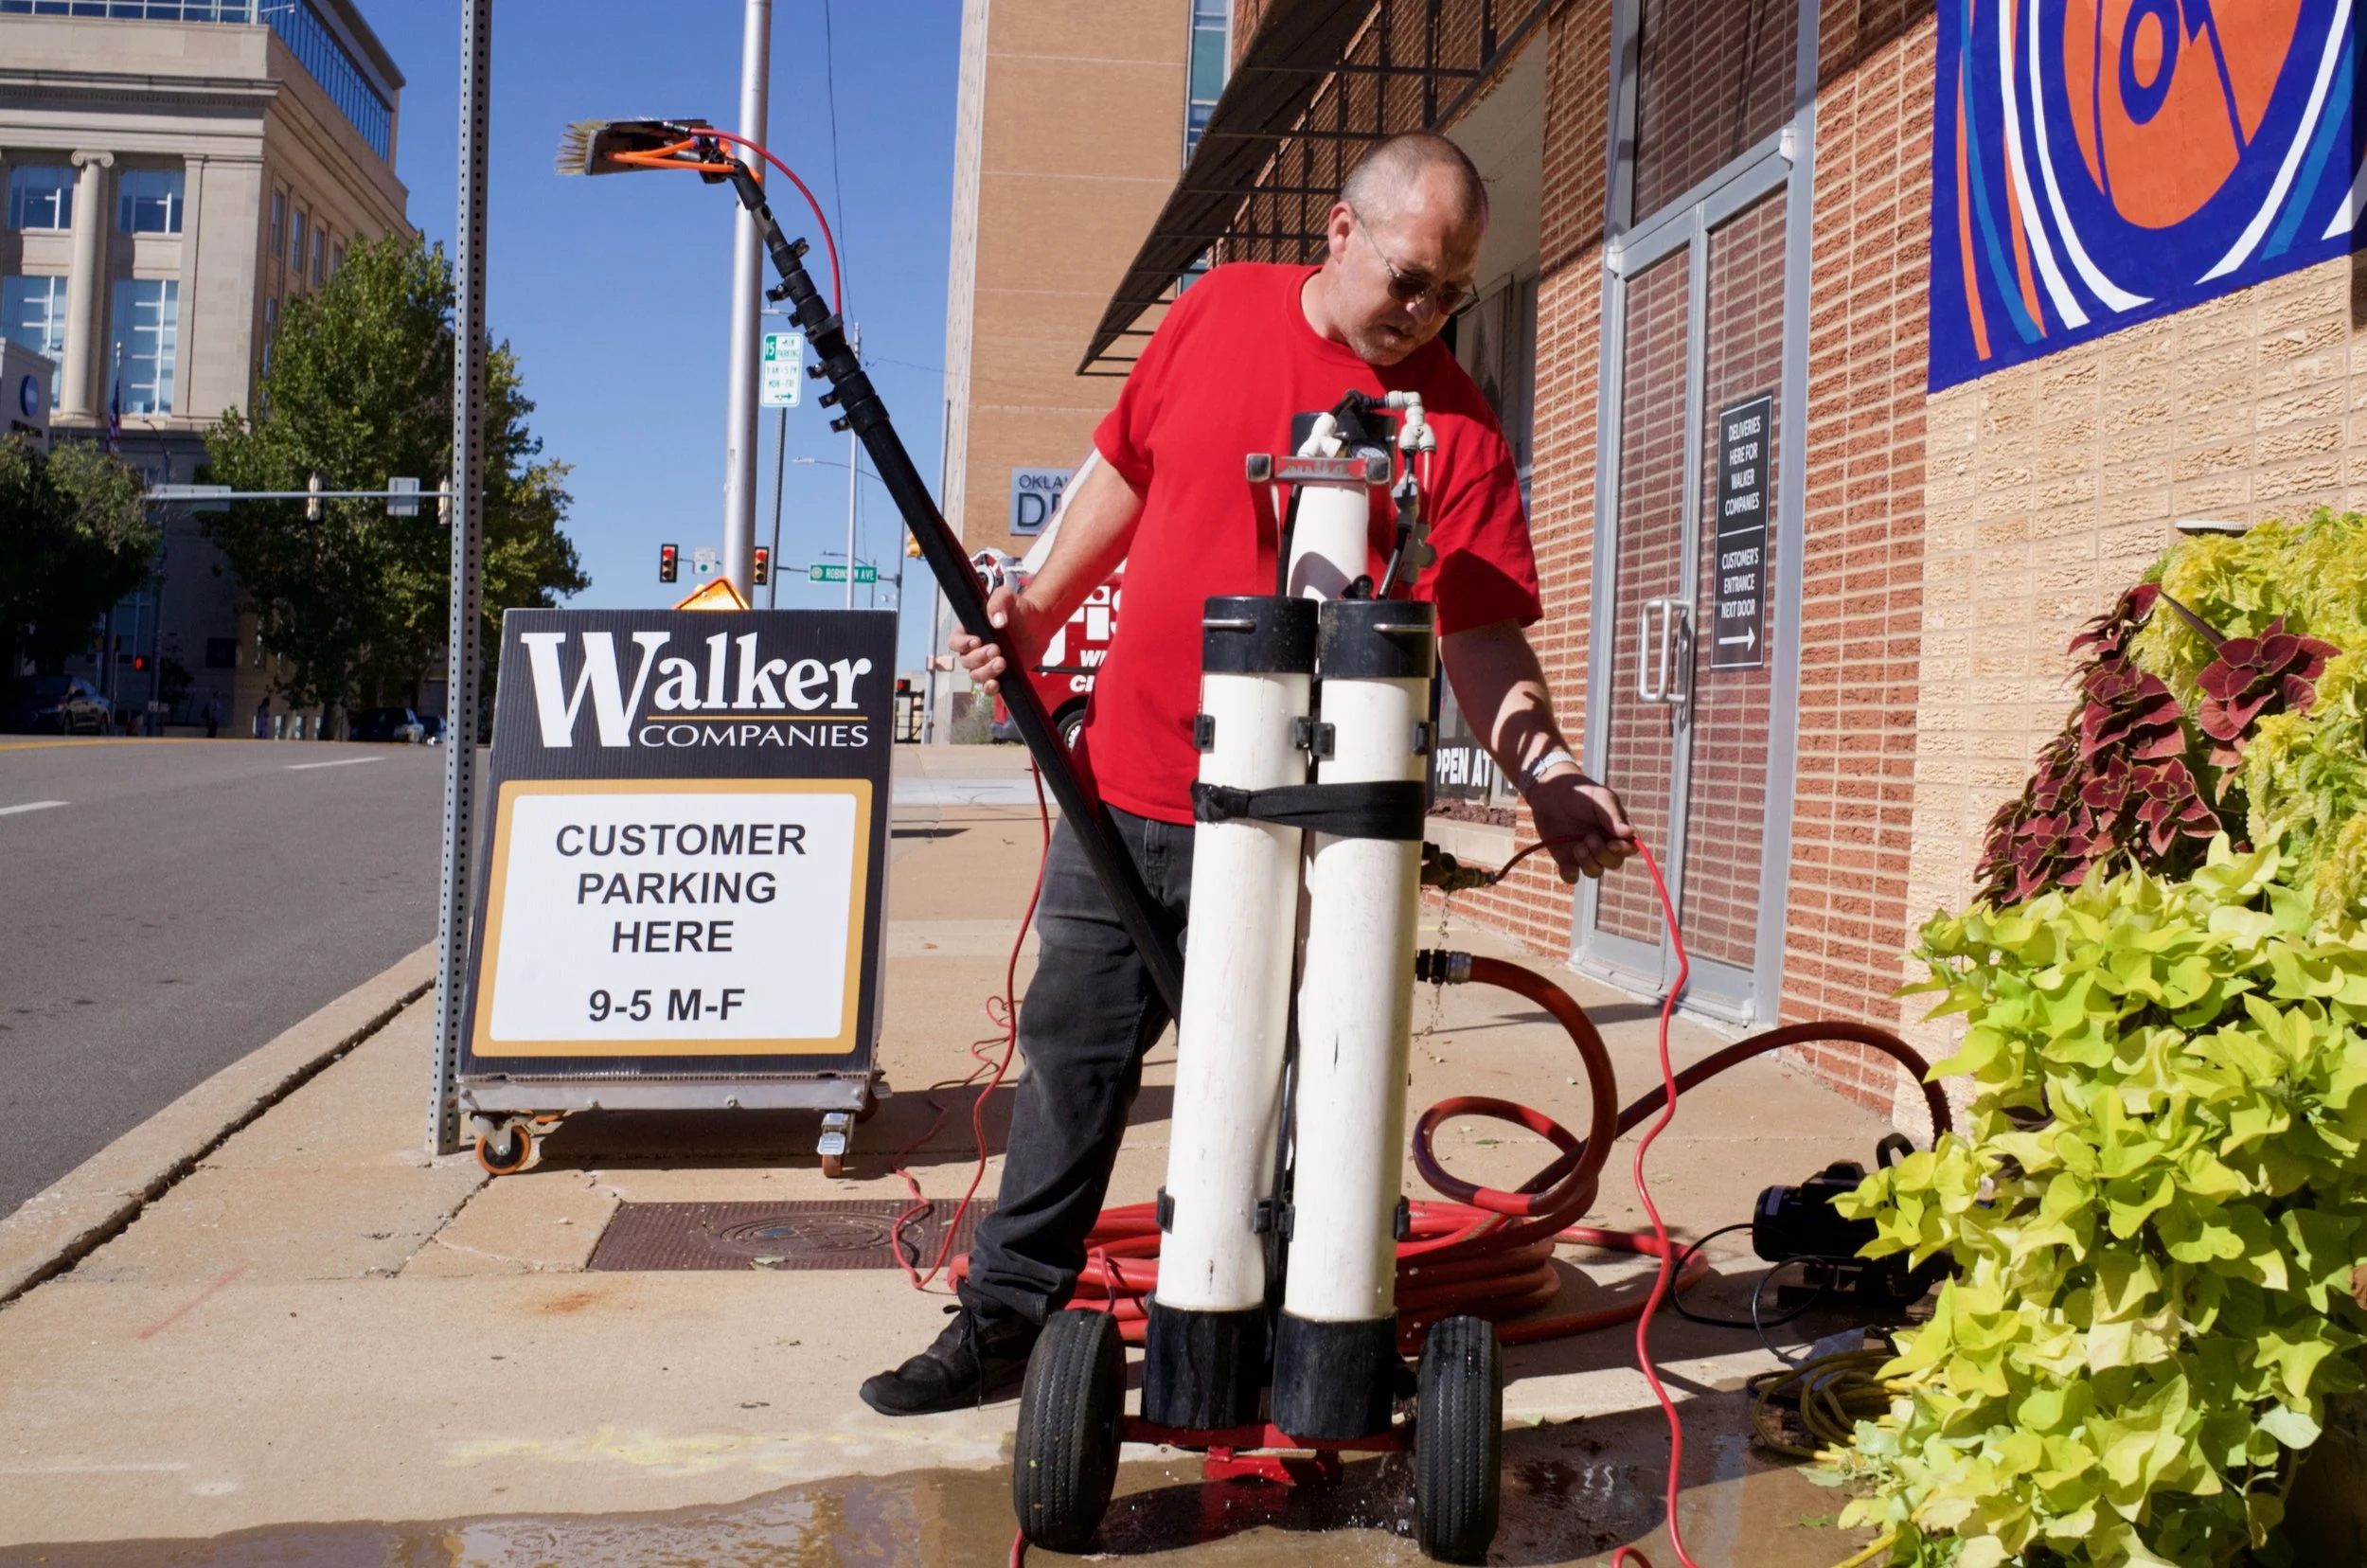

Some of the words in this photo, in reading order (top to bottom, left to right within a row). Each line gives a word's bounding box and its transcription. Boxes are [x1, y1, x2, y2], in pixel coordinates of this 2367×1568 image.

[766, 341, 775, 356] 15
[776, 348, 799, 358] PARKING
[1728, 415, 1761, 442] DELIVERIES
[1729, 445, 1745, 466] HERE
[1745, 441, 1758, 461] FOR
[1019, 474, 1068, 489] OKLA
[1731, 468, 1754, 490] WALKER
[1725, 491, 1759, 516] COMPANIES
[1721, 546, 1759, 570] CUSTOMER'S
[826, 567, 859, 580] ROBINSN
[860, 568, 875, 580] AVE
[1723, 573, 1755, 595] ENTRANCE
[1720, 600, 1737, 618] NEXT
[1737, 598, 1755, 617] DOOR
[520, 632, 872, 748] Walker
[638, 724, 869, 748] COMPANIES
[1470, 748, 1493, 787] AT
[556, 824, 806, 856] CUSTOMER
[577, 872, 776, 905] PARKING
[612, 920, 734, 953] HERE
[588, 989, 652, 1022] 9-5
[667, 989, 746, 1021] M-F
